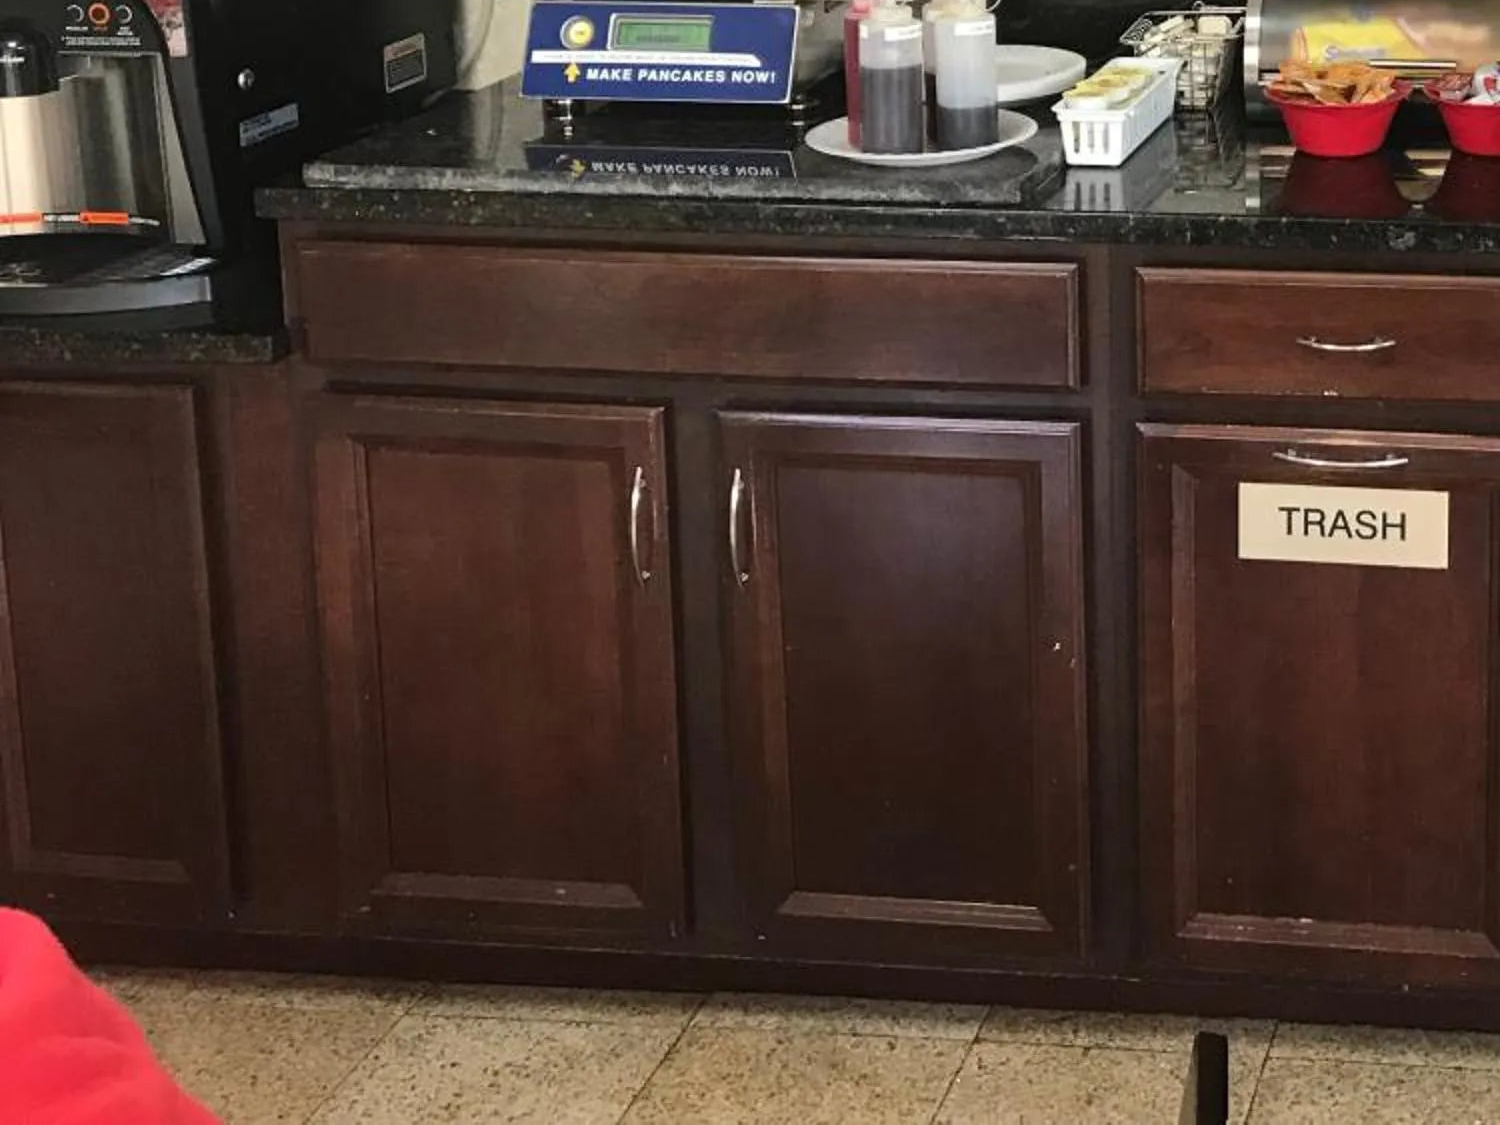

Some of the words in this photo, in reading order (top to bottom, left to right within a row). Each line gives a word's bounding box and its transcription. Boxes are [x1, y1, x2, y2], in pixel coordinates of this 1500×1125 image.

[586, 67, 633, 82] MAKE
[638, 68, 726, 84] PANCAKES
[731, 70, 776, 85] NOW!
[1278, 506, 1407, 541] TRASH
